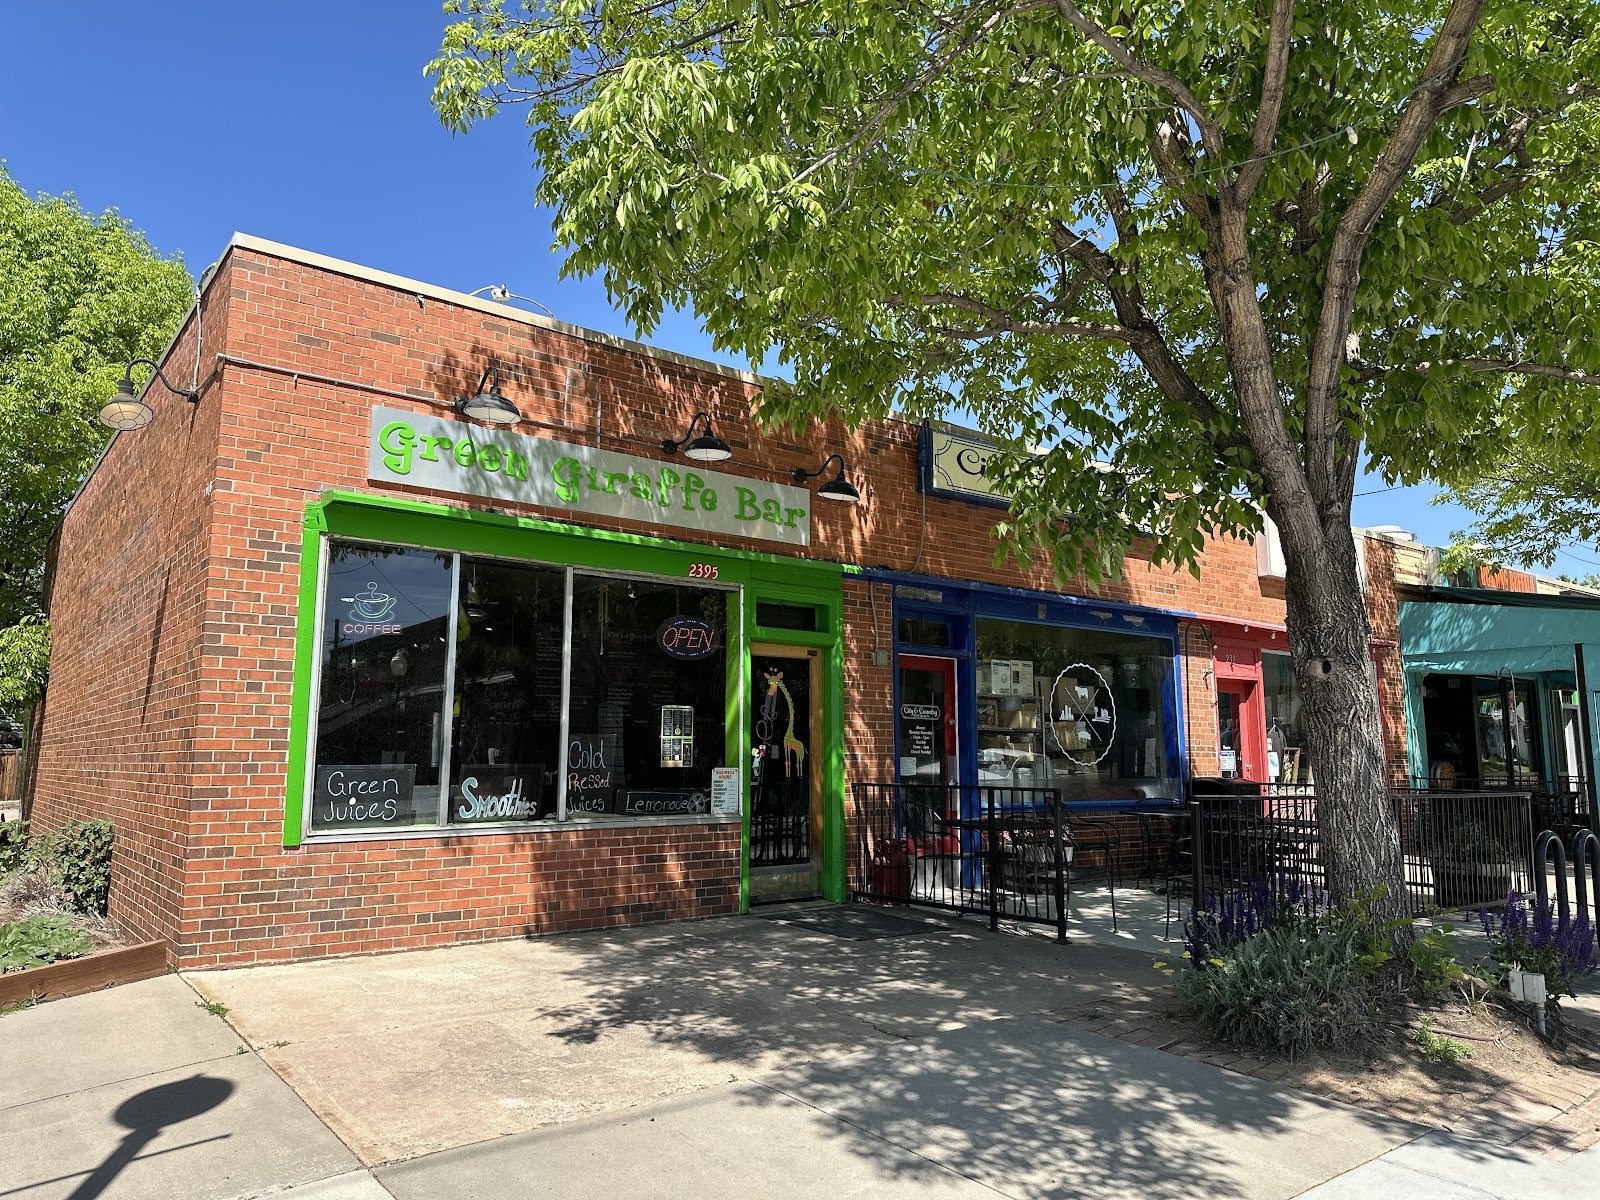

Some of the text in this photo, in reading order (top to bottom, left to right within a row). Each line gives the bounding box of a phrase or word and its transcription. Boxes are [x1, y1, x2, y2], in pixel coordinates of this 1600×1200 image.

[378, 421, 806, 530] Green Giraffe Bar
[688, 563, 719, 580] 2395
[343, 623, 401, 634] COFFEE
[662, 627, 715, 649] OPEN
[568, 739, 606, 769] Cold
[327, 771, 399, 796] Green
[459, 776, 537, 818] Smoothies
[566, 796, 605, 815] Juices
[626, 793, 688, 811] Lemonade
[323, 797, 397, 821] Juices
